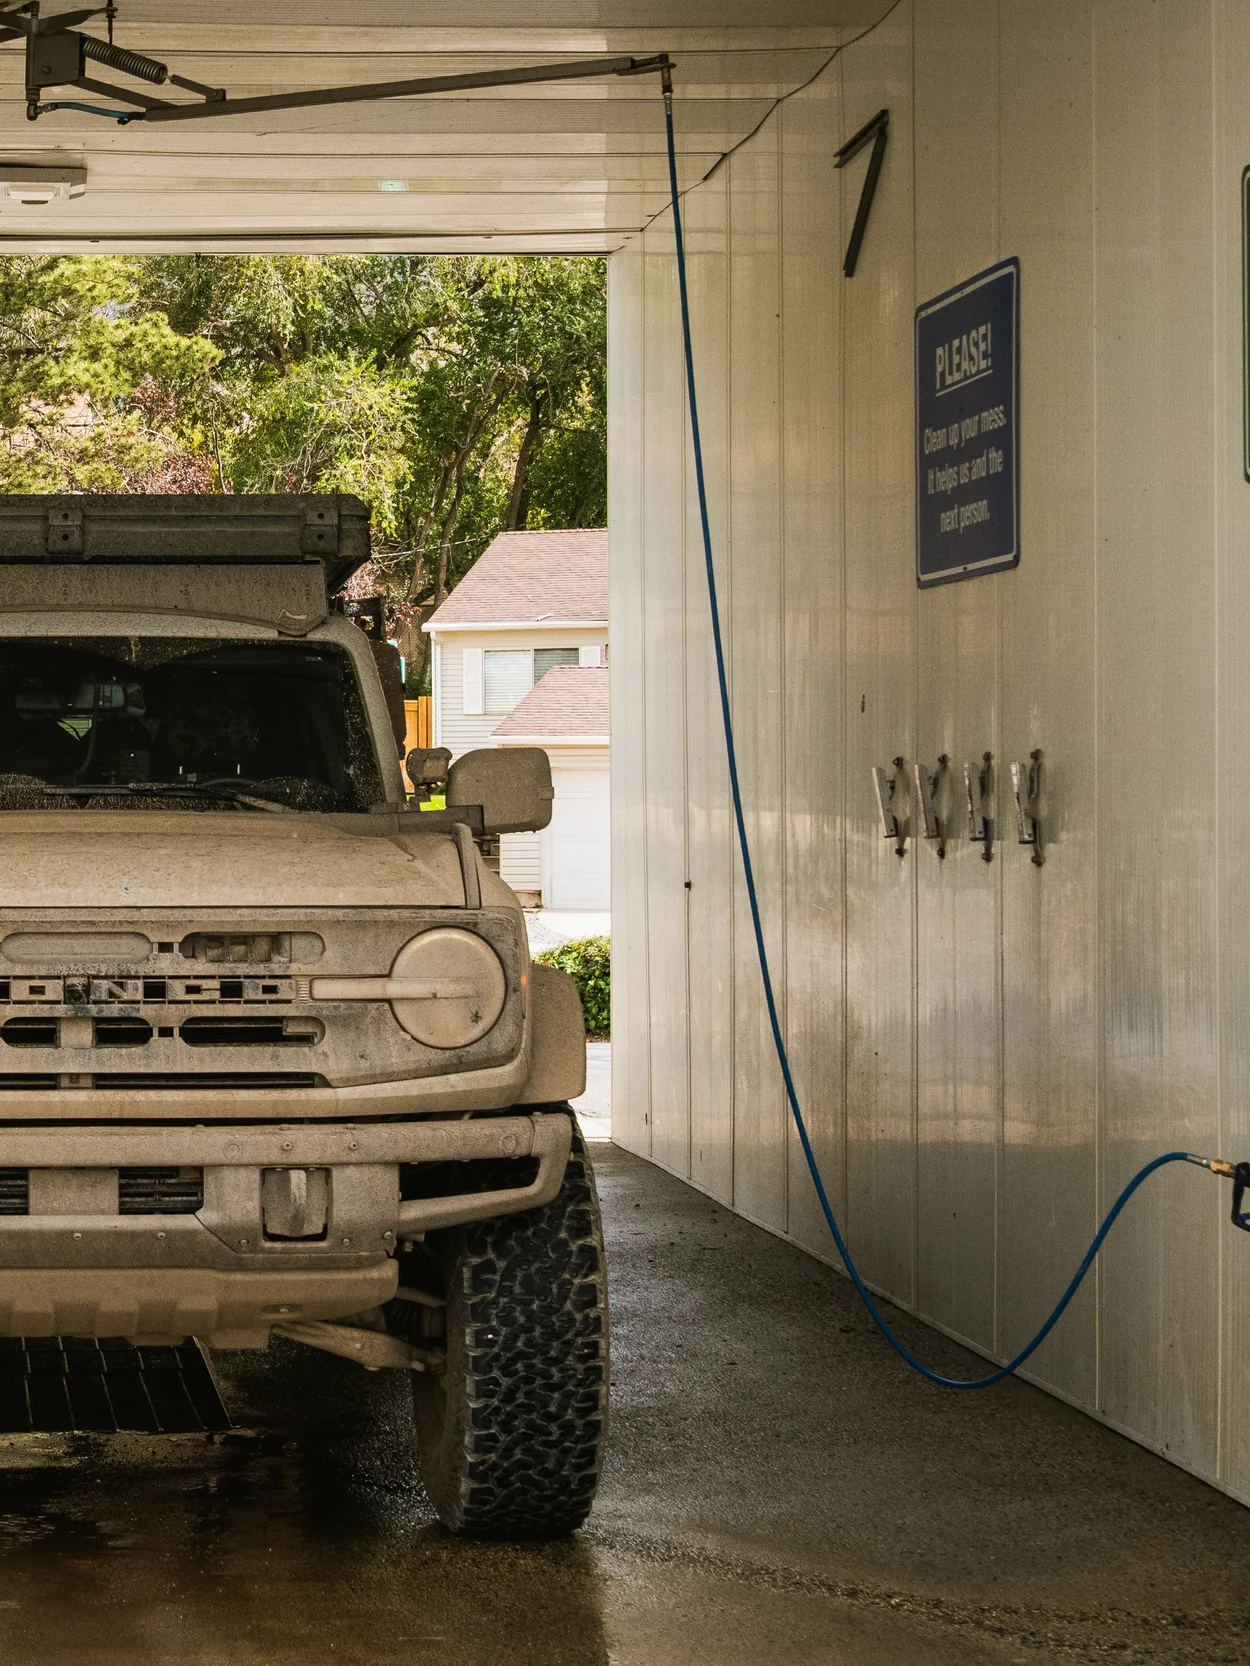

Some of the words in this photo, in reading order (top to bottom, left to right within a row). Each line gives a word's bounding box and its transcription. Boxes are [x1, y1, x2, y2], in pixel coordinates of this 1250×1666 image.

[935, 322, 992, 389] PLEASE!
[924, 427, 947, 454] Clean
[948, 423, 959, 450] up
[960, 414, 979, 447] your
[981, 405, 1007, 432] mess.
[927, 468, 935, 494] It
[936, 464, 958, 494] helps
[959, 462, 970, 484] us
[971, 449, 987, 480] and
[988, 446, 1003, 474] the
[940, 503, 958, 533] next
[959, 499, 991, 533] person.
